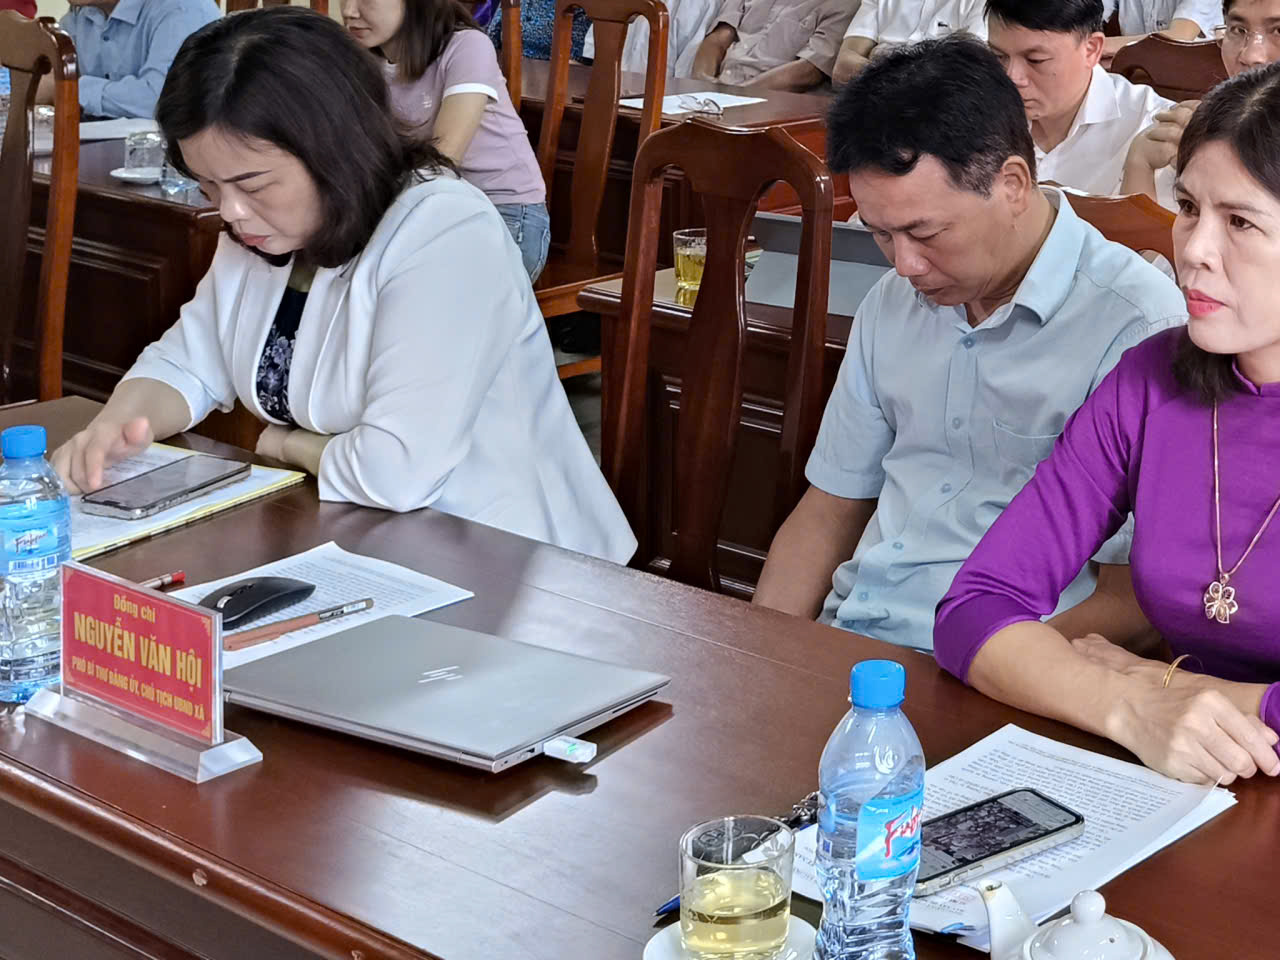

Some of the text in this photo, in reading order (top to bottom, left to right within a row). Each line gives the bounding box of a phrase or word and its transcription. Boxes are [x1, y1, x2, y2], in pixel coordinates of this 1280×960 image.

[113, 594, 156, 623] Đồng chí
[74, 612, 203, 692] NGUYỄN VĂN HỘI
